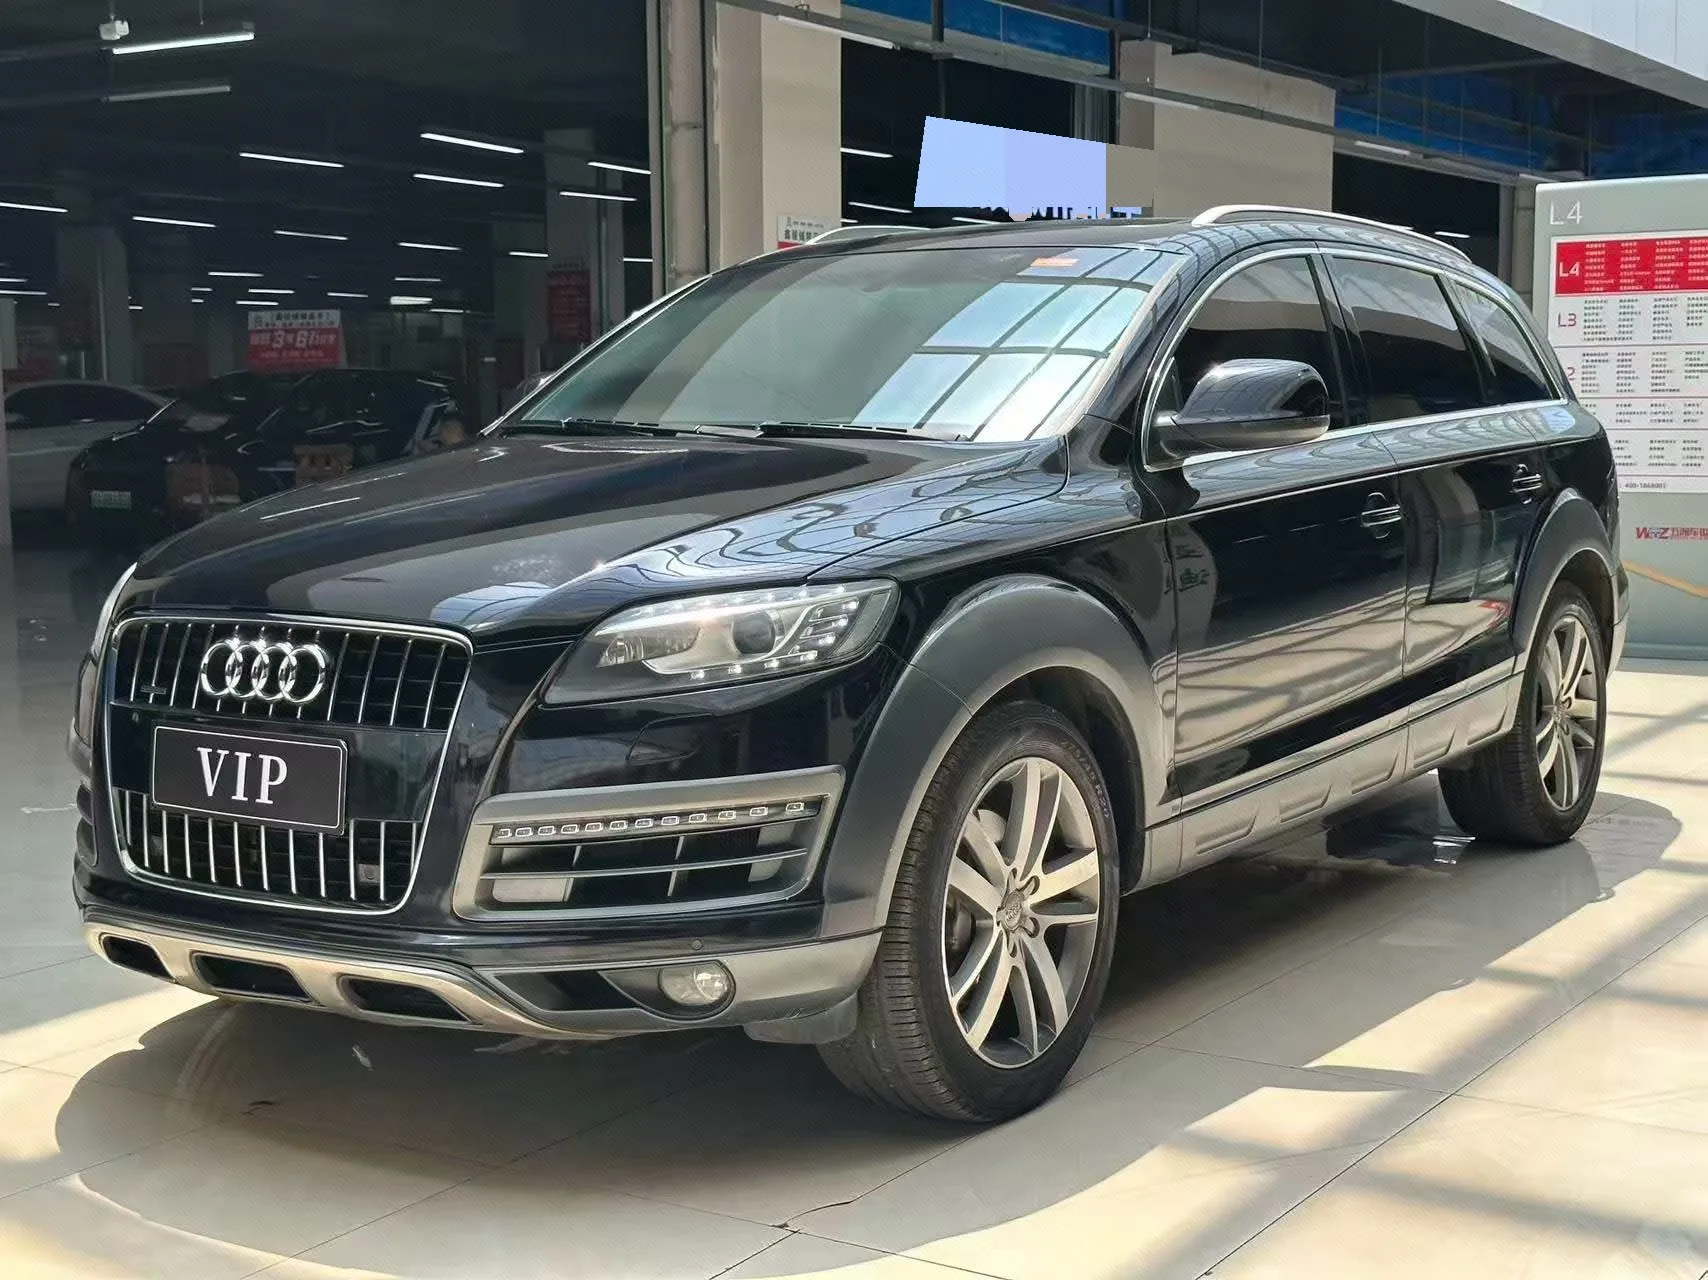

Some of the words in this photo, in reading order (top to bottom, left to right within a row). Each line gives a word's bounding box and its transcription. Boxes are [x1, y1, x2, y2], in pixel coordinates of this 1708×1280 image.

[1550, 201, 1583, 225] L4
[1560, 261, 1580, 277] L4
[1558, 312, 1577, 328] L3
[197, 747, 288, 805] VIP
